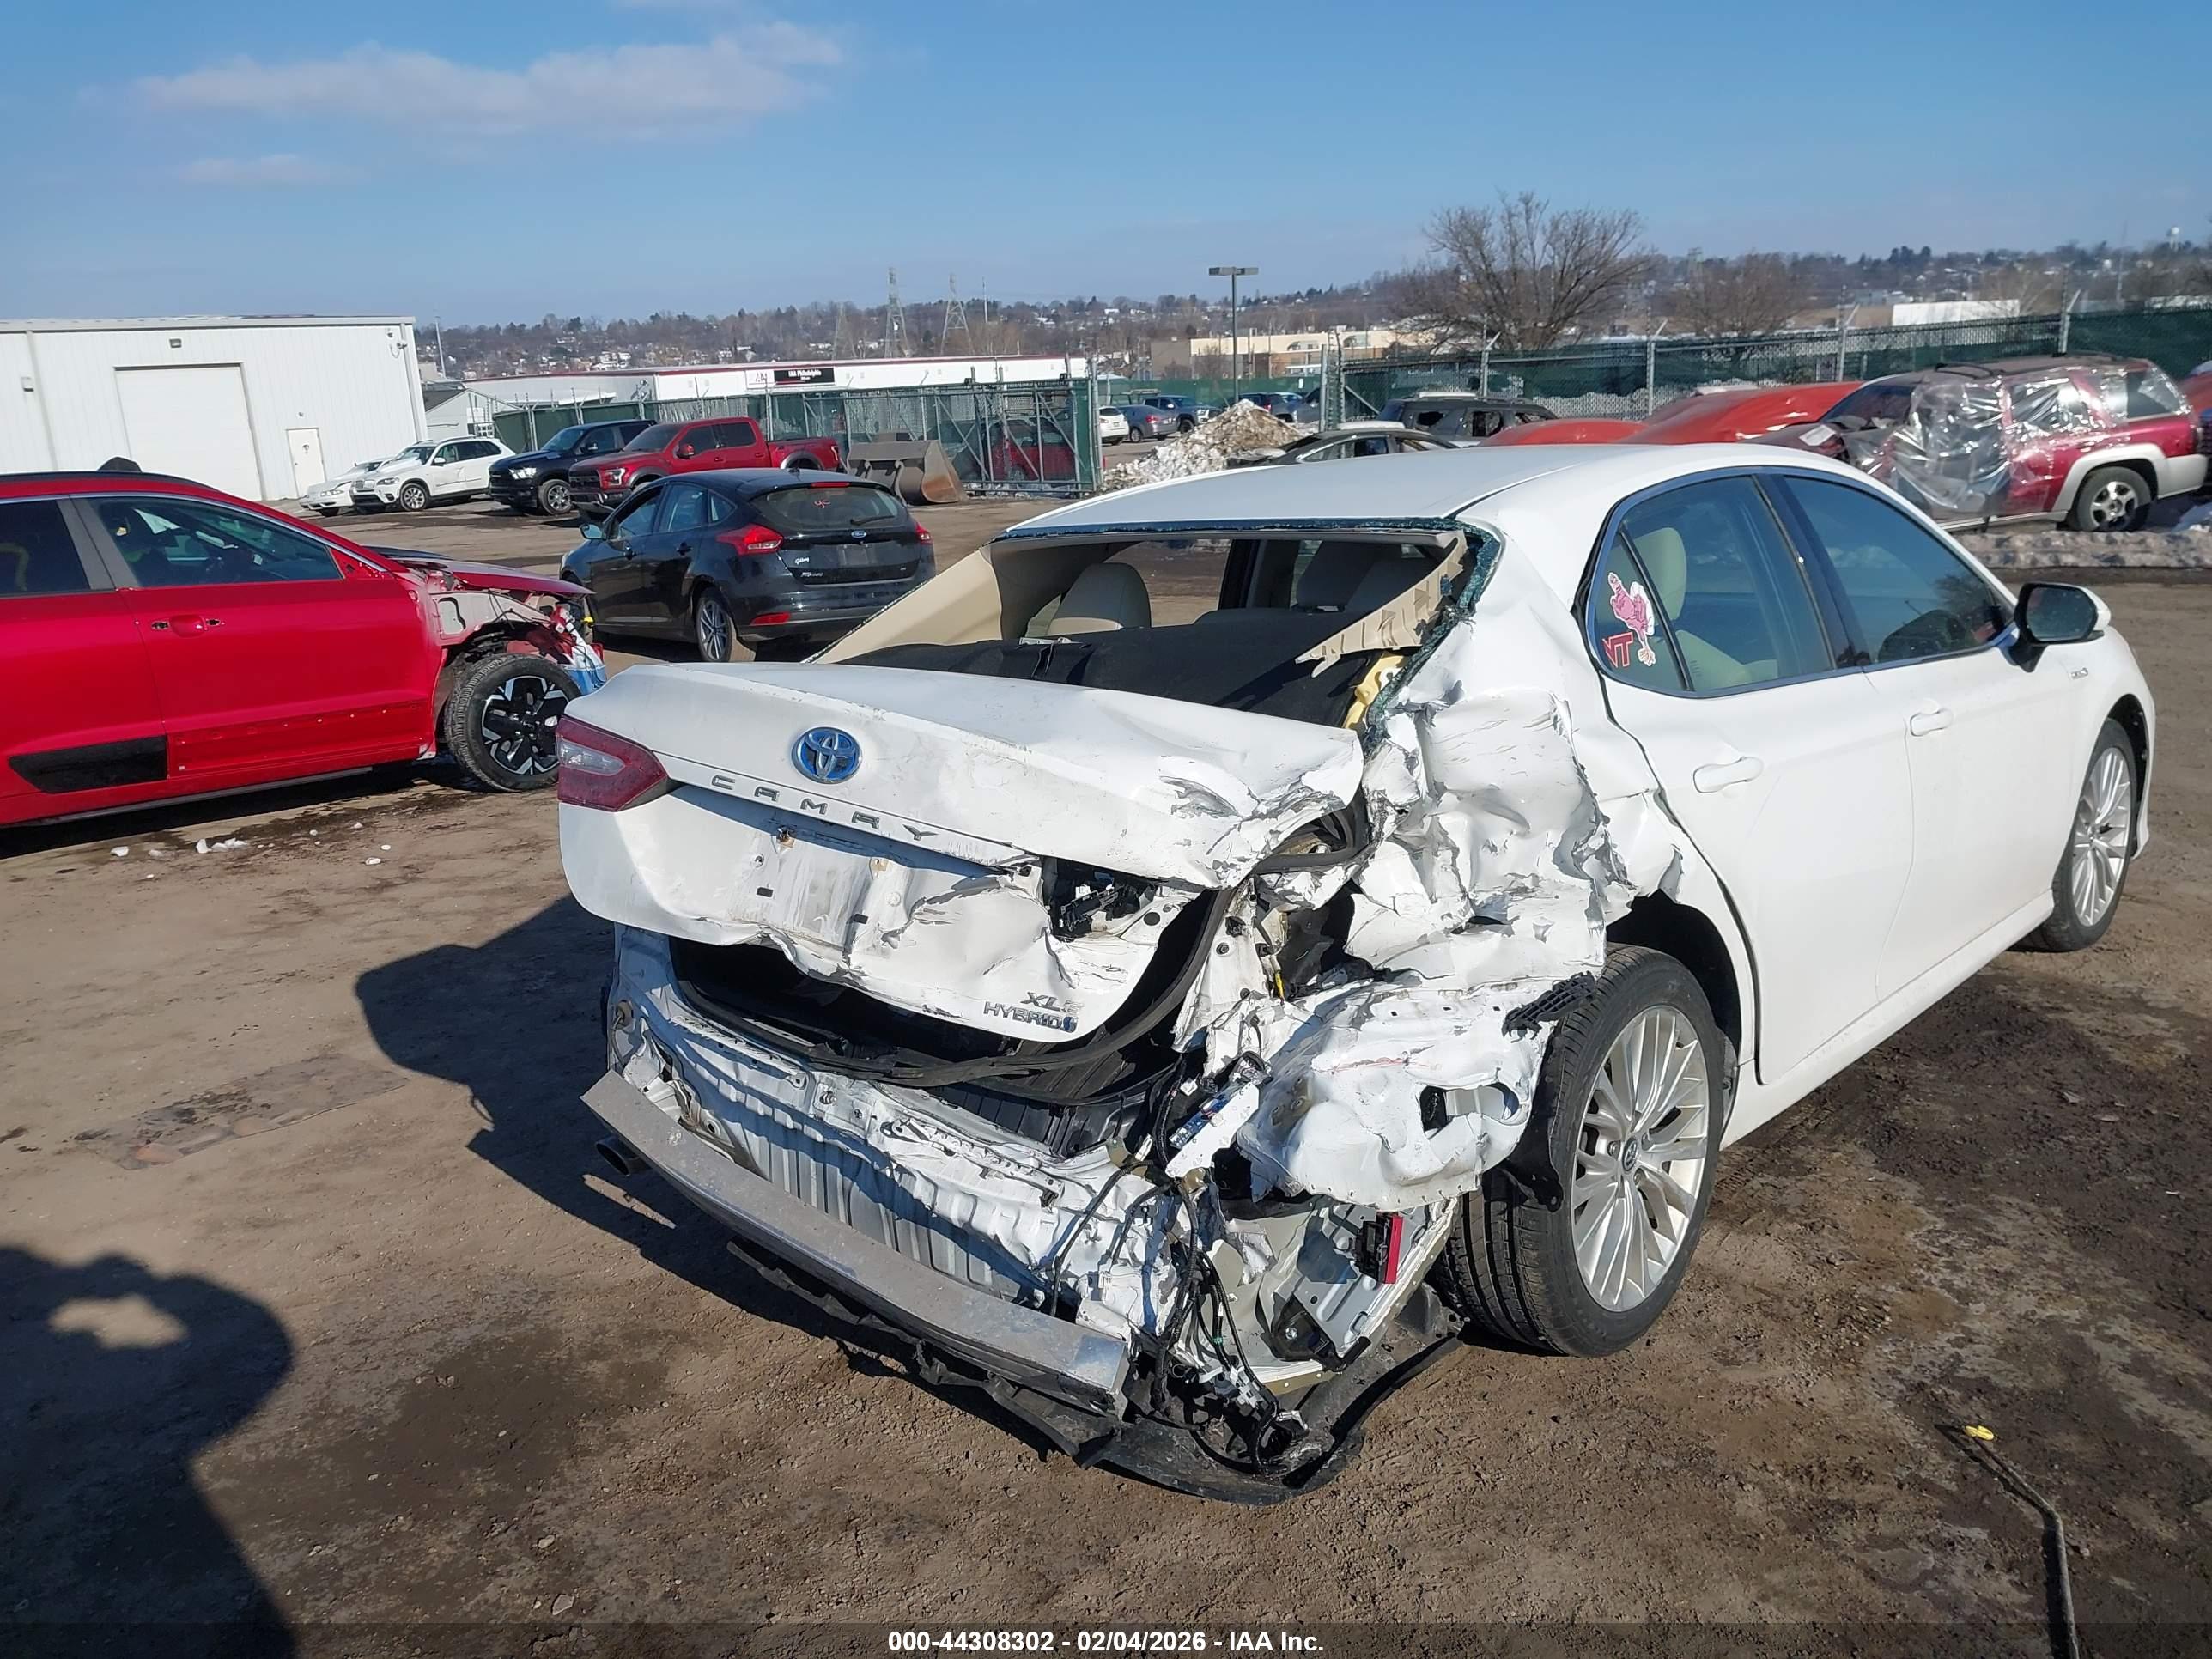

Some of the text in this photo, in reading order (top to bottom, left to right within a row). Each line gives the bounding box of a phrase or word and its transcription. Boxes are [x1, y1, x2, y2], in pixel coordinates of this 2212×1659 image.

[1601, 632, 1634, 668] VT
[711, 775, 939, 842] CAMRY
[983, 1001, 1063, 1029] HYBRID
